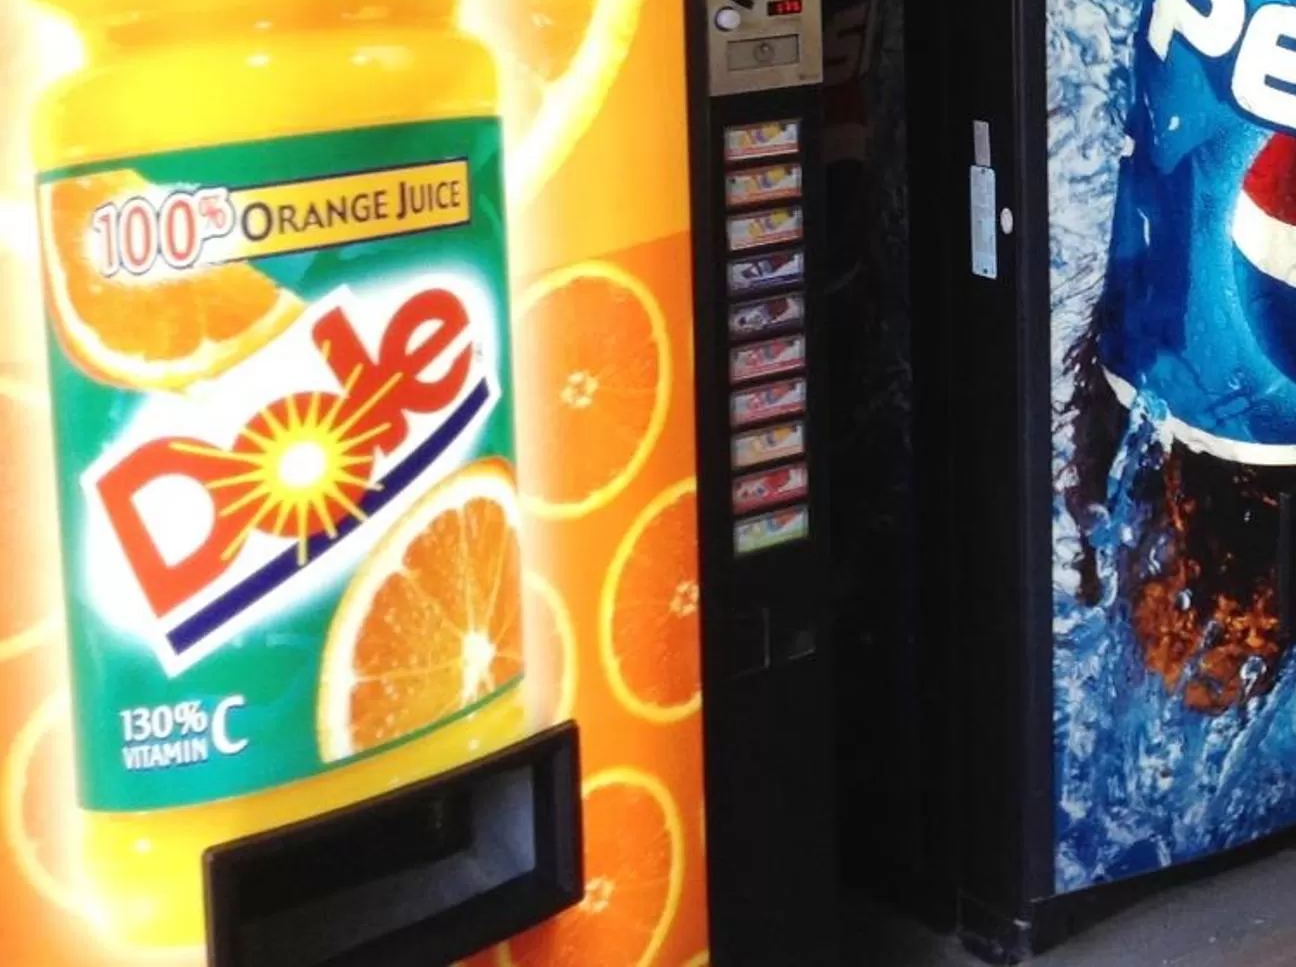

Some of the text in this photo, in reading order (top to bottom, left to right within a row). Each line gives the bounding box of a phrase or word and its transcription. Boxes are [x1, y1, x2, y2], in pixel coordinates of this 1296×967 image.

[96, 180, 461, 275] 100% ORANGE JUICE
[96, 288, 474, 619] Dole
[120, 699, 208, 741] 130%
[122, 694, 249, 770] VITAMIN C
